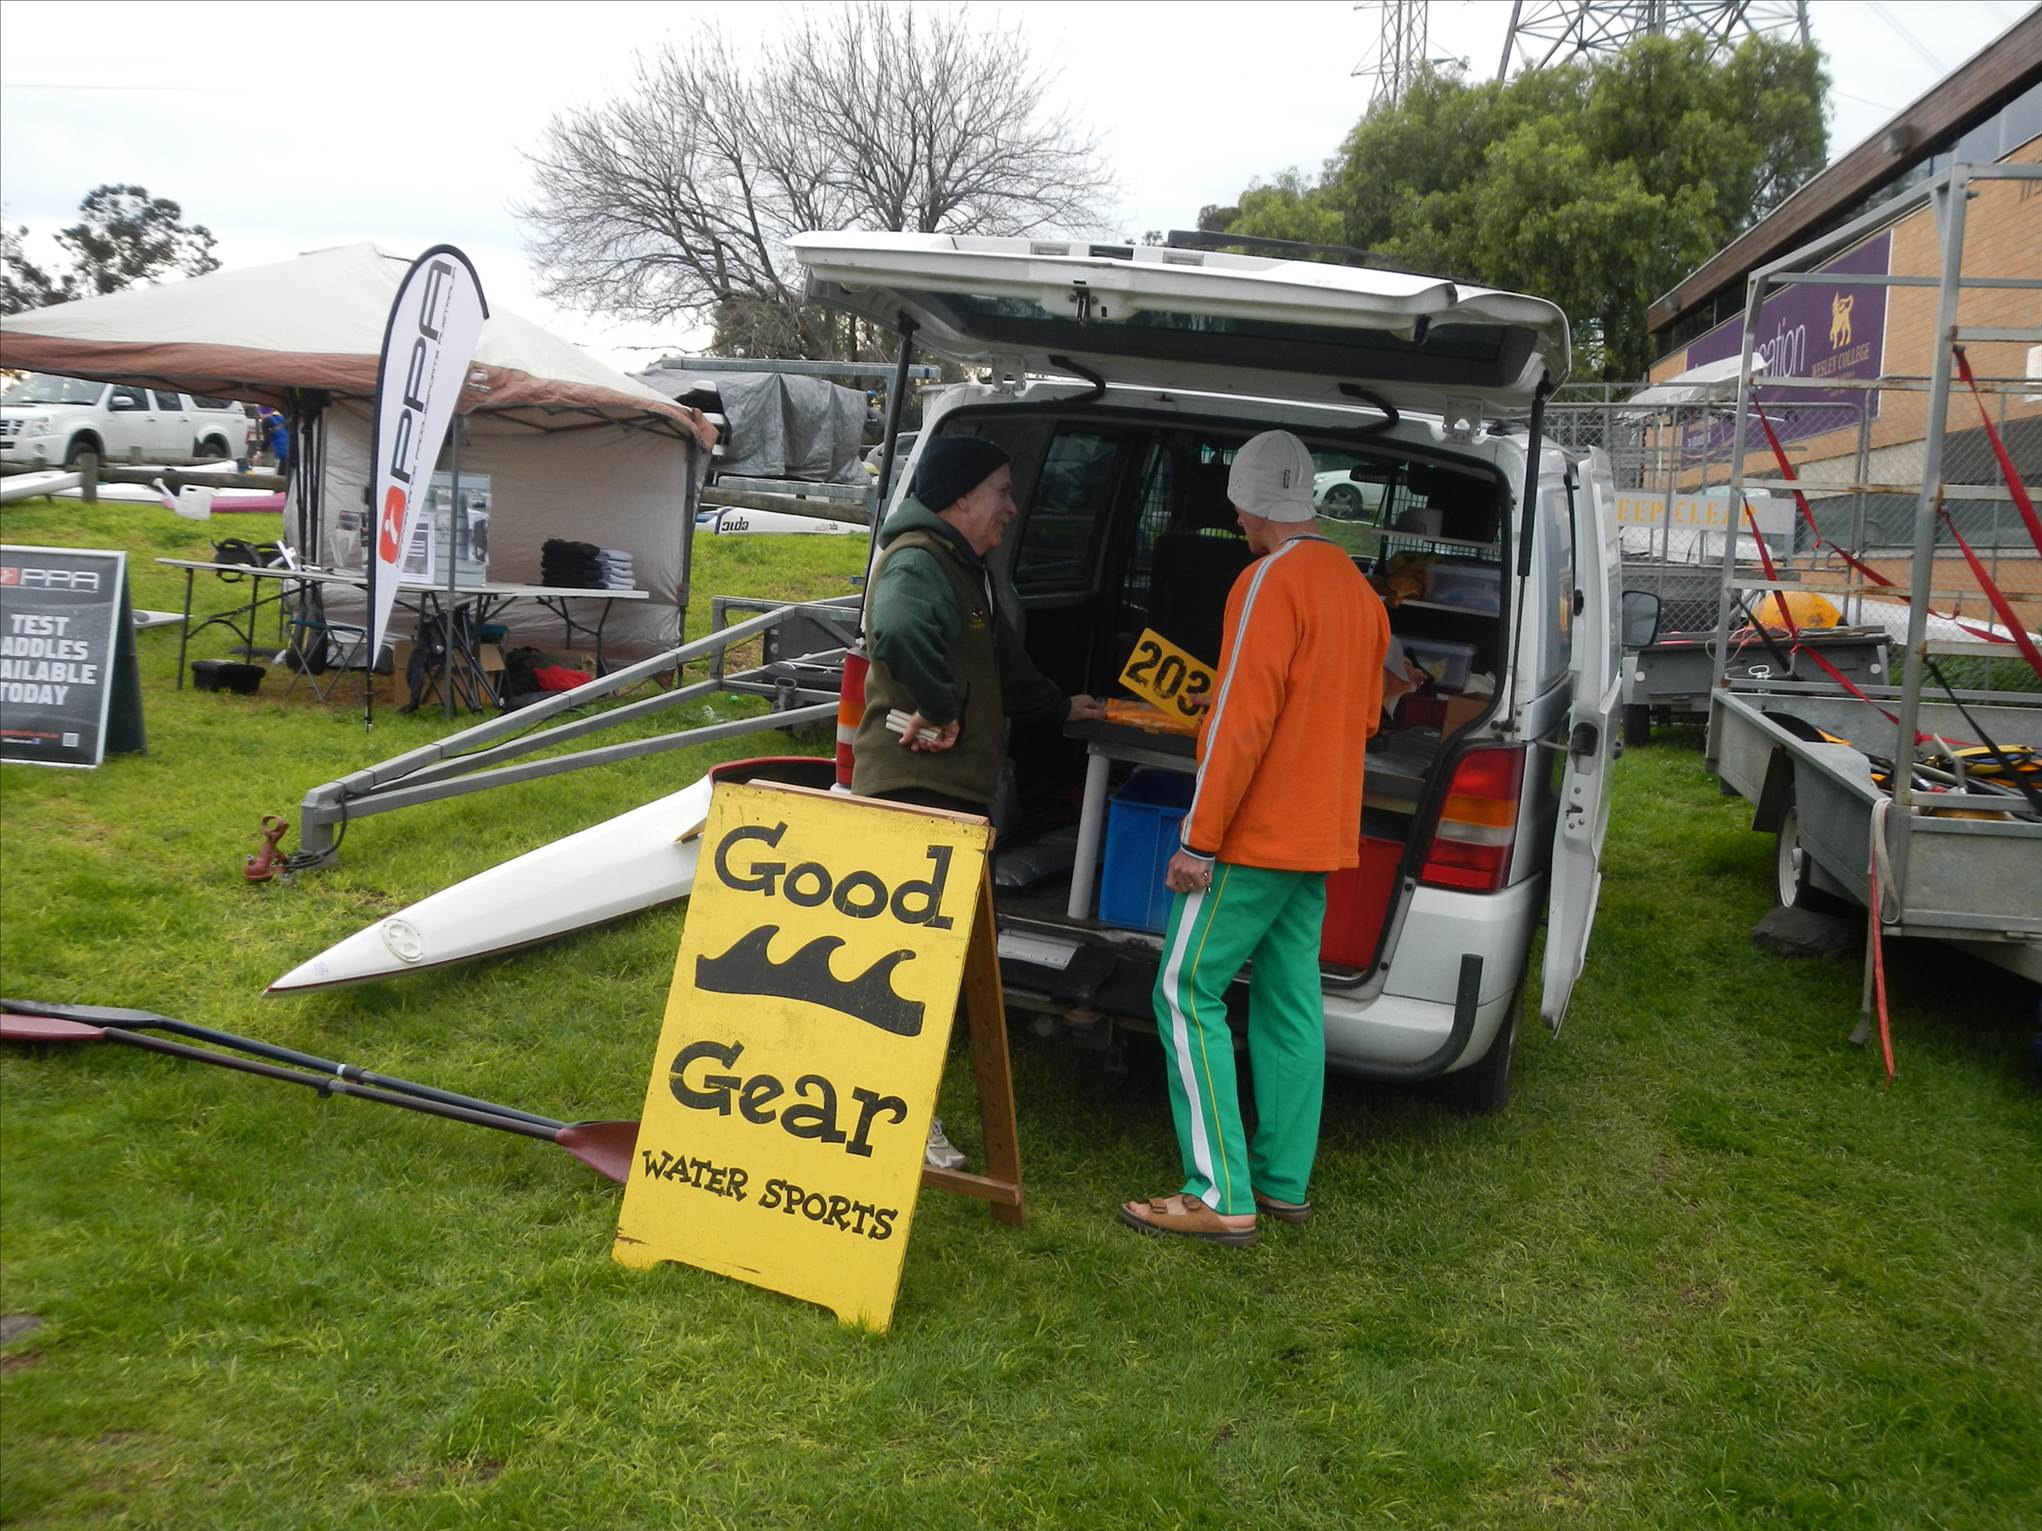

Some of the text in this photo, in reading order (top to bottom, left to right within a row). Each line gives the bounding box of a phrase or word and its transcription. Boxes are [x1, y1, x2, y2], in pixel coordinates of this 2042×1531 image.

[1837, 341, 1871, 370] COLLEGE
[391, 260, 453, 485] PPA
[1674, 501, 1758, 527] CLER
[20, 568, 99, 590] PPA
[10, 613, 70, 636] TEST
[0, 636, 89, 661] ADDLES
[0, 658, 98, 685] AILABLE
[0, 681, 70, 706] TODAY
[713, 821, 955, 930] Good
[668, 1040, 908, 1157] Gear
[642, 1149, 898, 1241] WATER SPORTS
